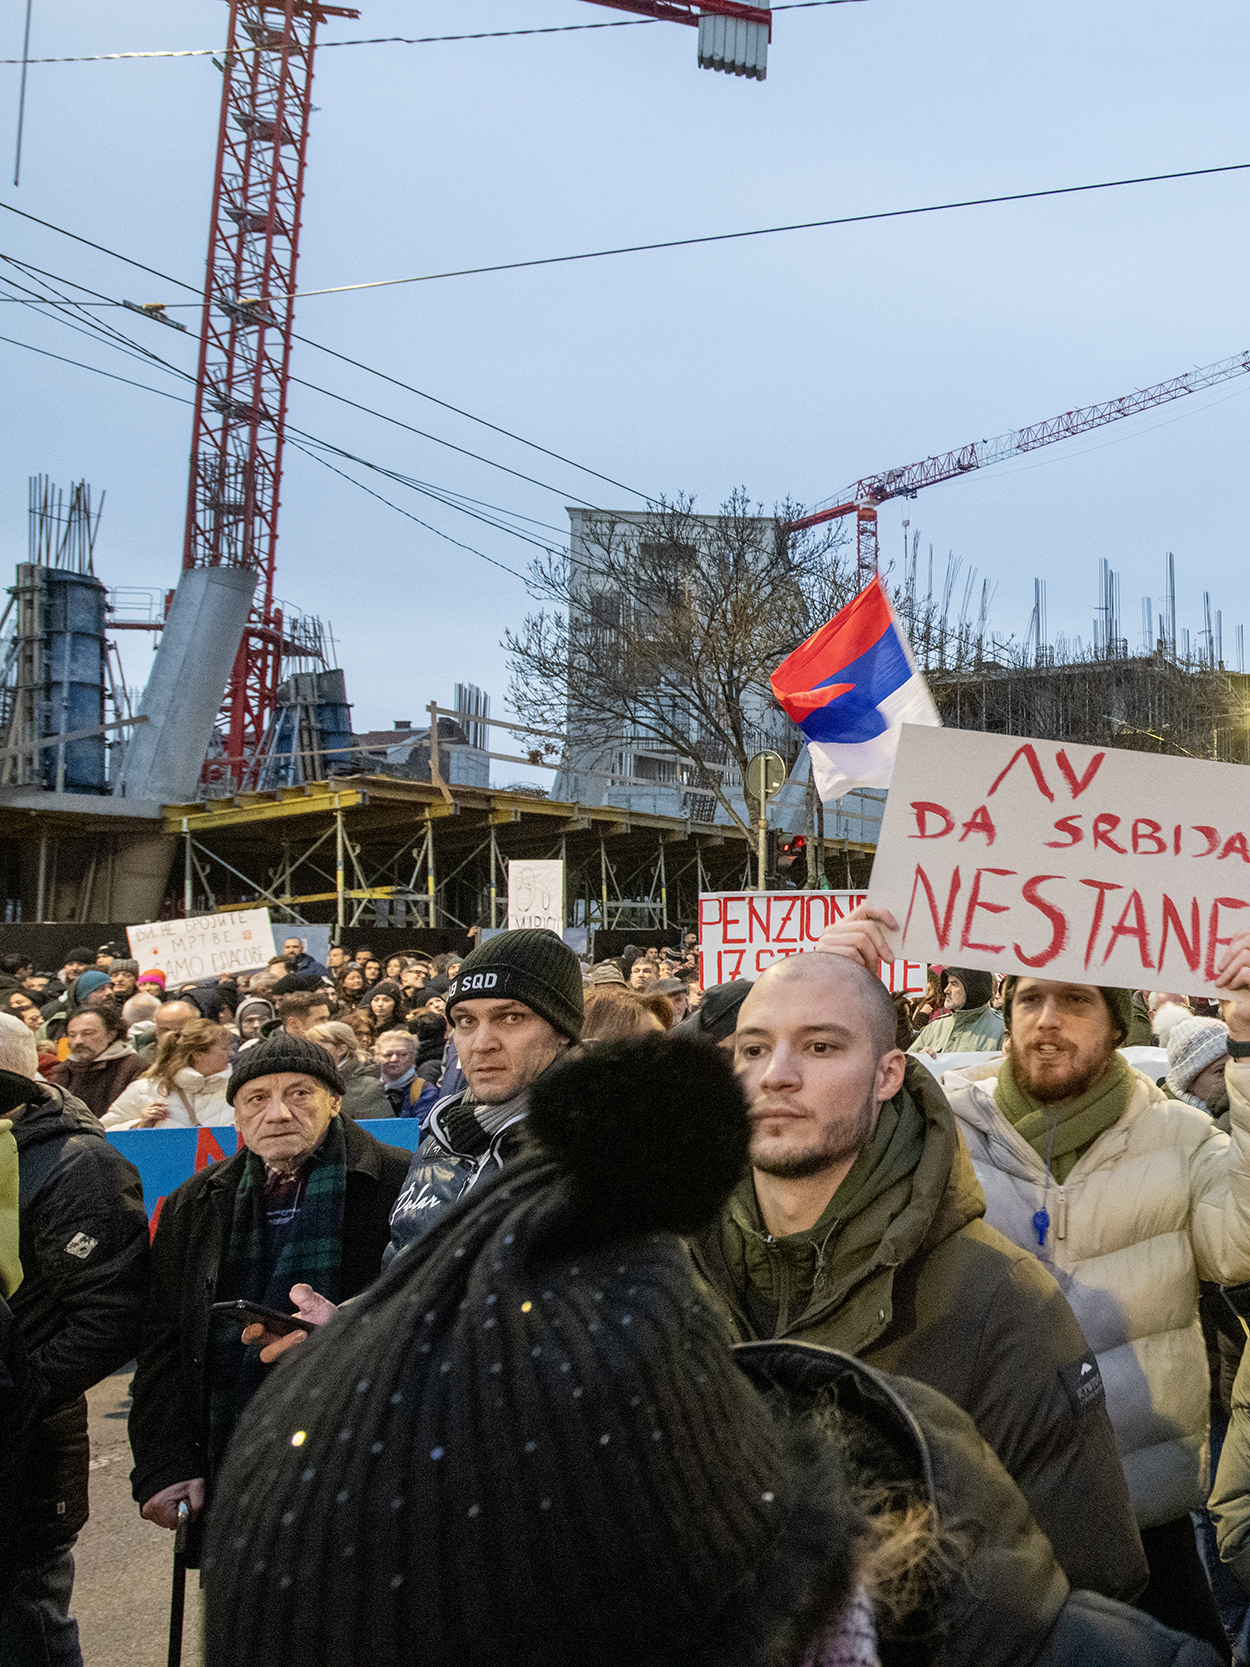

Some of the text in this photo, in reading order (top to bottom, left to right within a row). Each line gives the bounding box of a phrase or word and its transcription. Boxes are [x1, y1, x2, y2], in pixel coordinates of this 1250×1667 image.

[908, 801, 996, 846] DA
[135, 911, 248, 942] ВИ НЕ БРОЈИТЕ
[699, 895, 867, 945] PENZION
[171, 930, 232, 953] МРТВЕ
[211, 946, 267, 972] ГЛАСОВЕ
[461, 973, 498, 992] SQD
